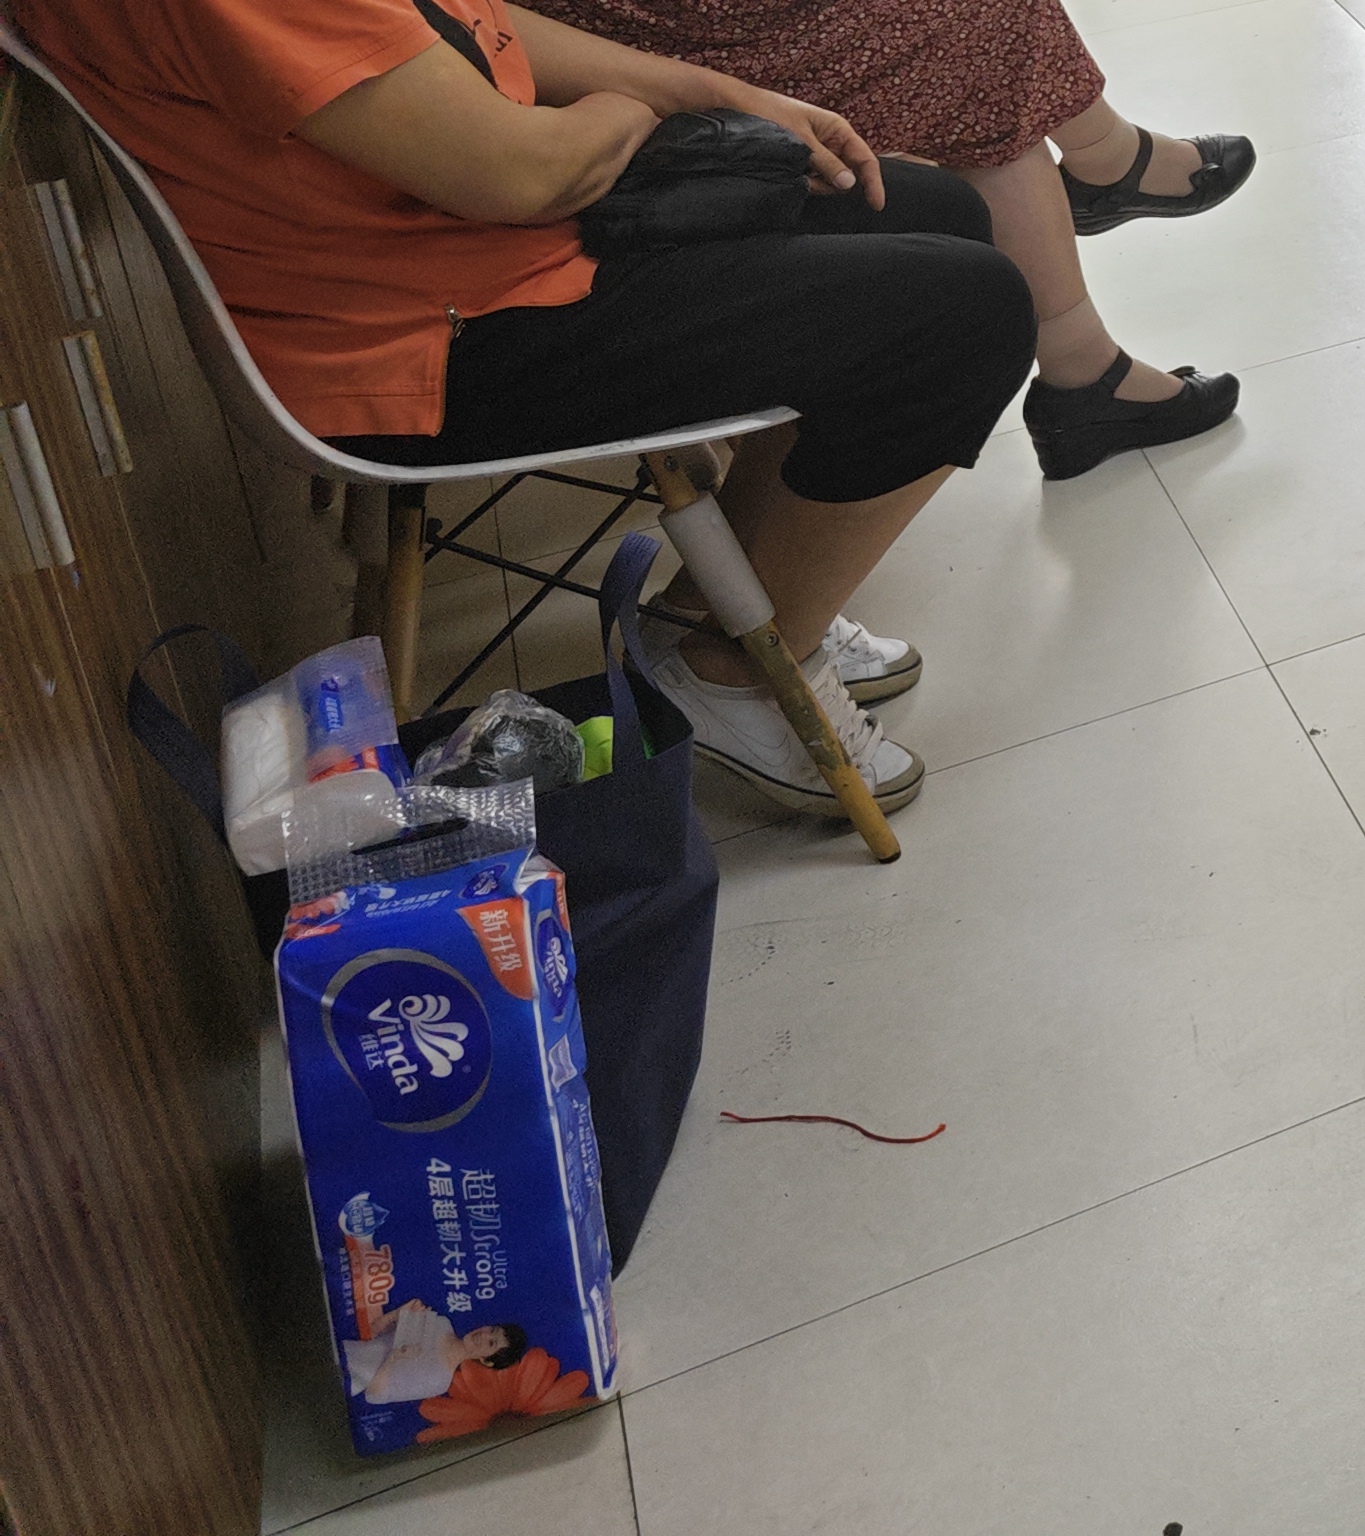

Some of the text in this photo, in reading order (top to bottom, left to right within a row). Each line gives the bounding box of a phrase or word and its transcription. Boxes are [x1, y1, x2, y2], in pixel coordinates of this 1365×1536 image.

[481, 907, 522, 975] 新升级
[358, 1032, 385, 1072] 维达
[367, 997, 422, 1097] Vinda
[459, 1166, 500, 1232] 超韧
[425, 1158, 473, 1315] 4层超韧大升级
[364, 1245, 396, 1306] 780g
